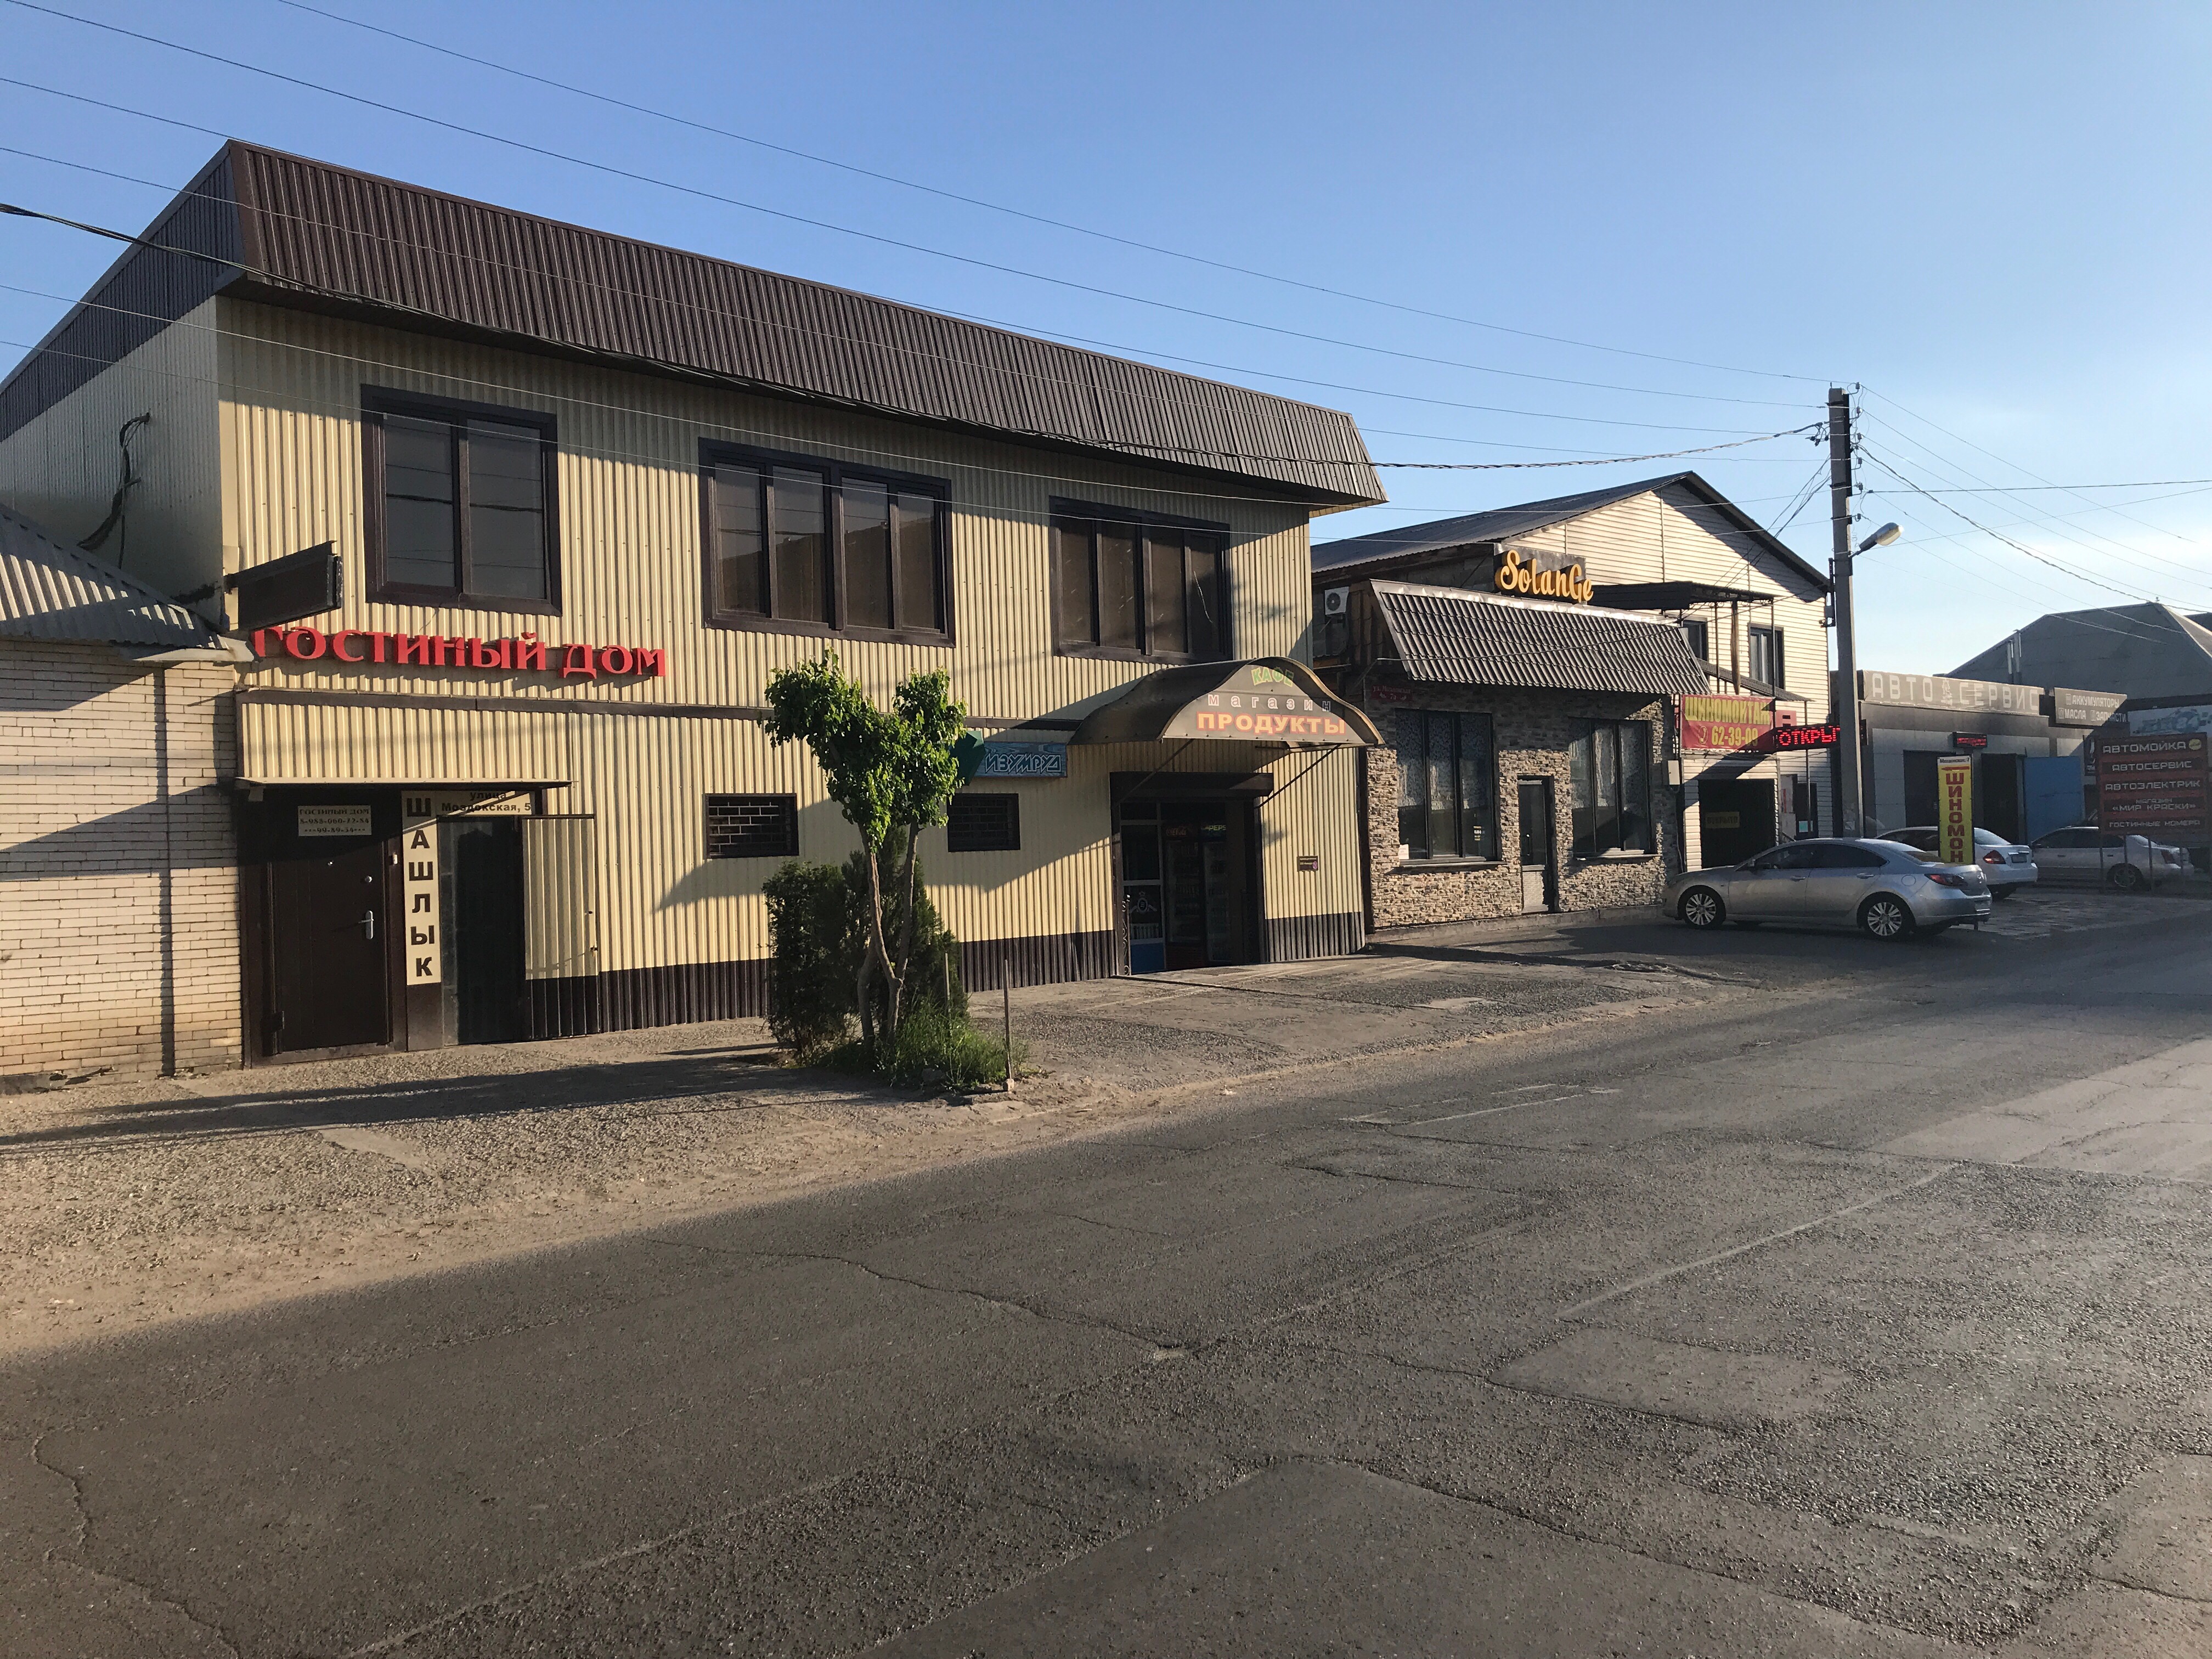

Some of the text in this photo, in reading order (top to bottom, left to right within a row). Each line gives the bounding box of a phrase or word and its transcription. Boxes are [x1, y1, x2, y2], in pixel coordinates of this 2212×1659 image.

[251, 626, 666, 679] ГОСТИНЫЙ ДОМ
[1251, 667, 1295, 687] КАФЕ
[1872, 673, 2040, 711] АВТО СЕРВИС
[1207, 693, 1331, 712] магазин
[2072, 695, 2120, 709] АККУМУЛЯТОРЫ
[2064, 708, 2086, 720] МАСЛА
[1197, 712, 1346, 736] ПРОДУКТЫ
[1711, 726, 1758, 746] 62-39-09
[2102, 741, 2186, 754] АВТОМОЙКА
[985, 752, 1062, 775] ИЗУМРУД
[2112, 760, 2192, 771] АВТОСЕРВИС
[2105, 780, 2200, 791] АВТОЭЛЕКТРИК
[470, 792, 507, 801] улица
[441, 802, 521, 812] Моздокская,
[407, 798, 435, 977] ШАШЛЫК
